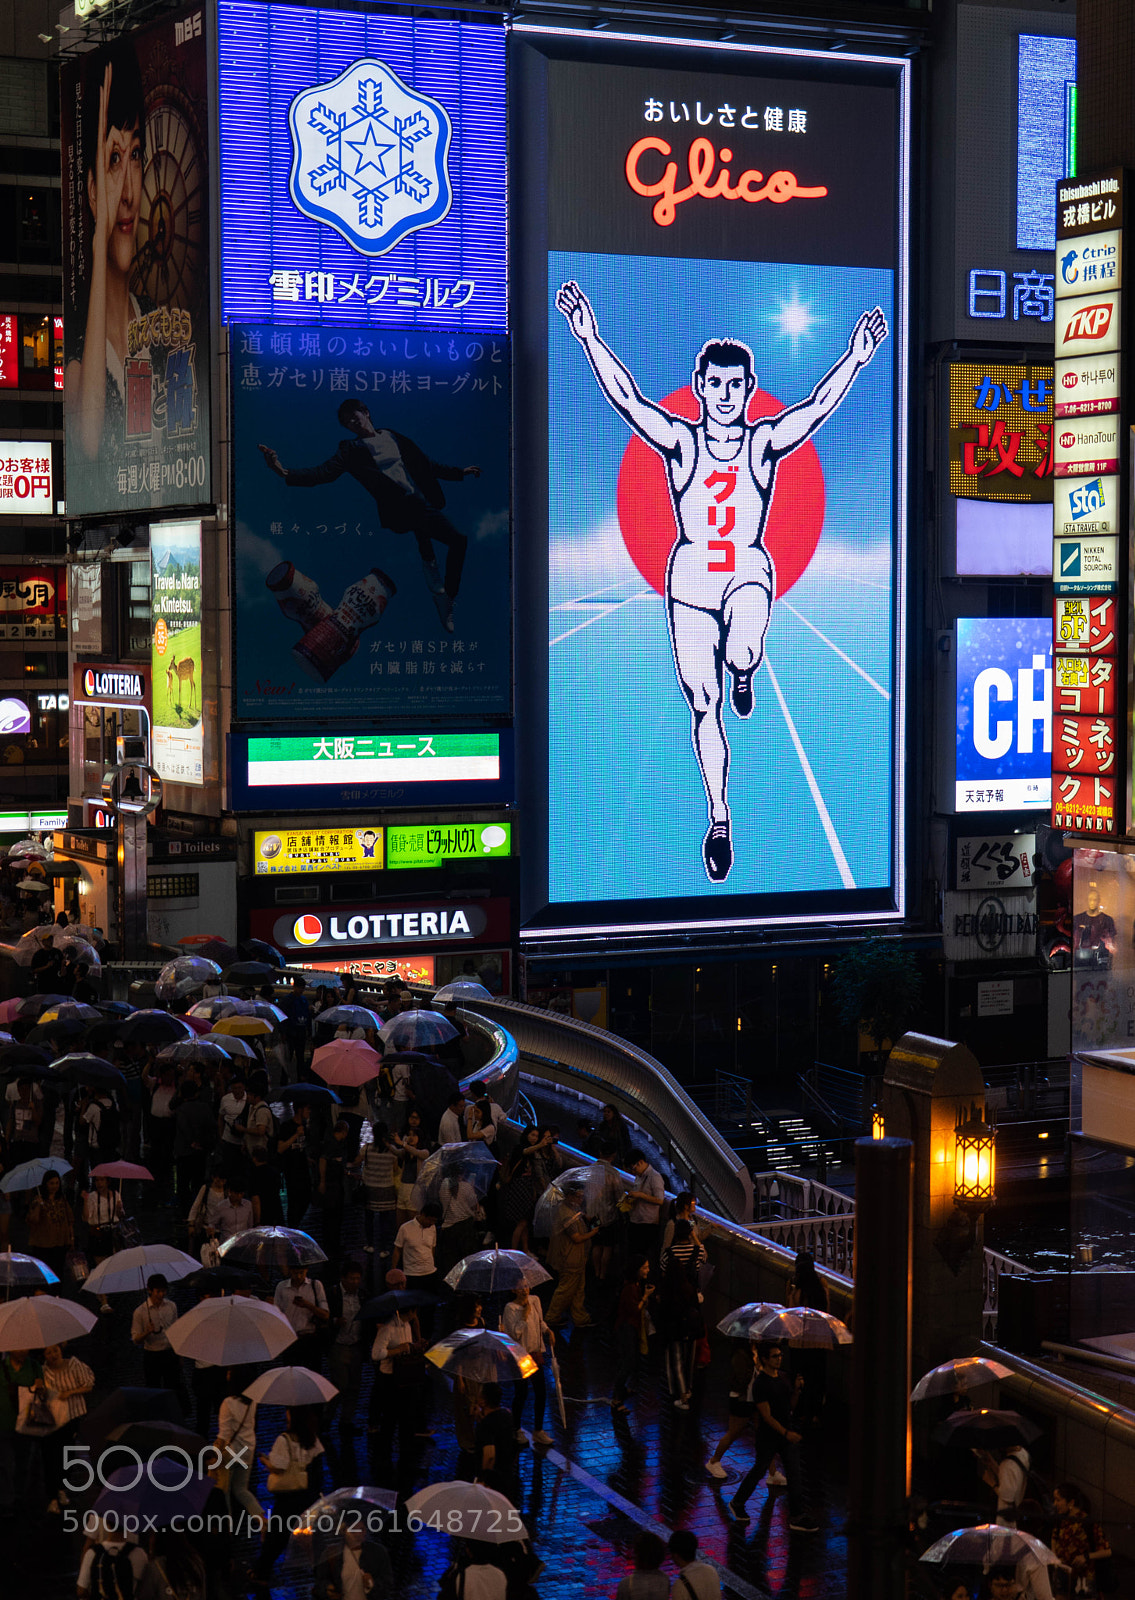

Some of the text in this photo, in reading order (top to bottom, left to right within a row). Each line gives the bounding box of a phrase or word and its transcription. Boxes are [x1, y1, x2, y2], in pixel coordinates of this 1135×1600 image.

[174, 11, 202, 47] MBS
[644, 98, 808, 133] おいしさと健康
[625, 136, 828, 226] Glico
[1059, 178, 1119, 202] Ebisubashi Bldg.
[1063, 199, 1116, 227] 戎橋ビル
[1082, 244, 1116, 260] Ctrip
[1083, 261, 1116, 281] 携程
[269, 270, 475, 308] 雪印メグミルク
[969, 269, 1055, 322] 日商
[1069, 307, 1109, 338] TKP
[240, 331, 503, 363] 道頓堀のおいしいものと
[240, 363, 503, 396] 恵ガセリ菌SP株ヨーグルト
[1081, 368, 1115, 385] 하나투어
[1077, 432, 1116, 445] HanaTour
[1097, 462, 1107, 471] 11F
[14, 475, 50, 499] 0円
[1072, 485, 1100, 514] sta
[270, 521, 376, 537] 軽々、つづく。
[704, 466, 739, 572] グリコ
[1065, 523, 1098, 533] STA TRAVEL
[1083, 563, 1112, 572] SOURCING
[154, 573, 175, 590] Travel
[181, 573, 199, 590] Nara
[161, 596, 193, 613] Kintetsu.
[1060, 616, 1087, 640] 5F
[370, 640, 479, 654] ガセリ菌SP株が
[370, 661, 488, 675] 内臓脂肪を減らす
[1057, 659, 1082, 673] 入口は
[95, 672, 142, 696] LOTTERIA
[1089, 598, 1115, 806] インターネット
[313, 737, 437, 760] 大阪ニュース
[1060, 689, 1085, 804] コミック
[341, 788, 405, 801] 雪印メグミルク
[965, 789, 1004, 803] 天気予報
[1055, 802, 1096, 815] 06-6212-2423
[184, 842, 220, 853] Toilets
[287, 834, 353, 848] 店舗情報館
[391, 828, 477, 854] 賃貸・売買 ピタットハウス
[330, 911, 470, 940] LOTTERIA
